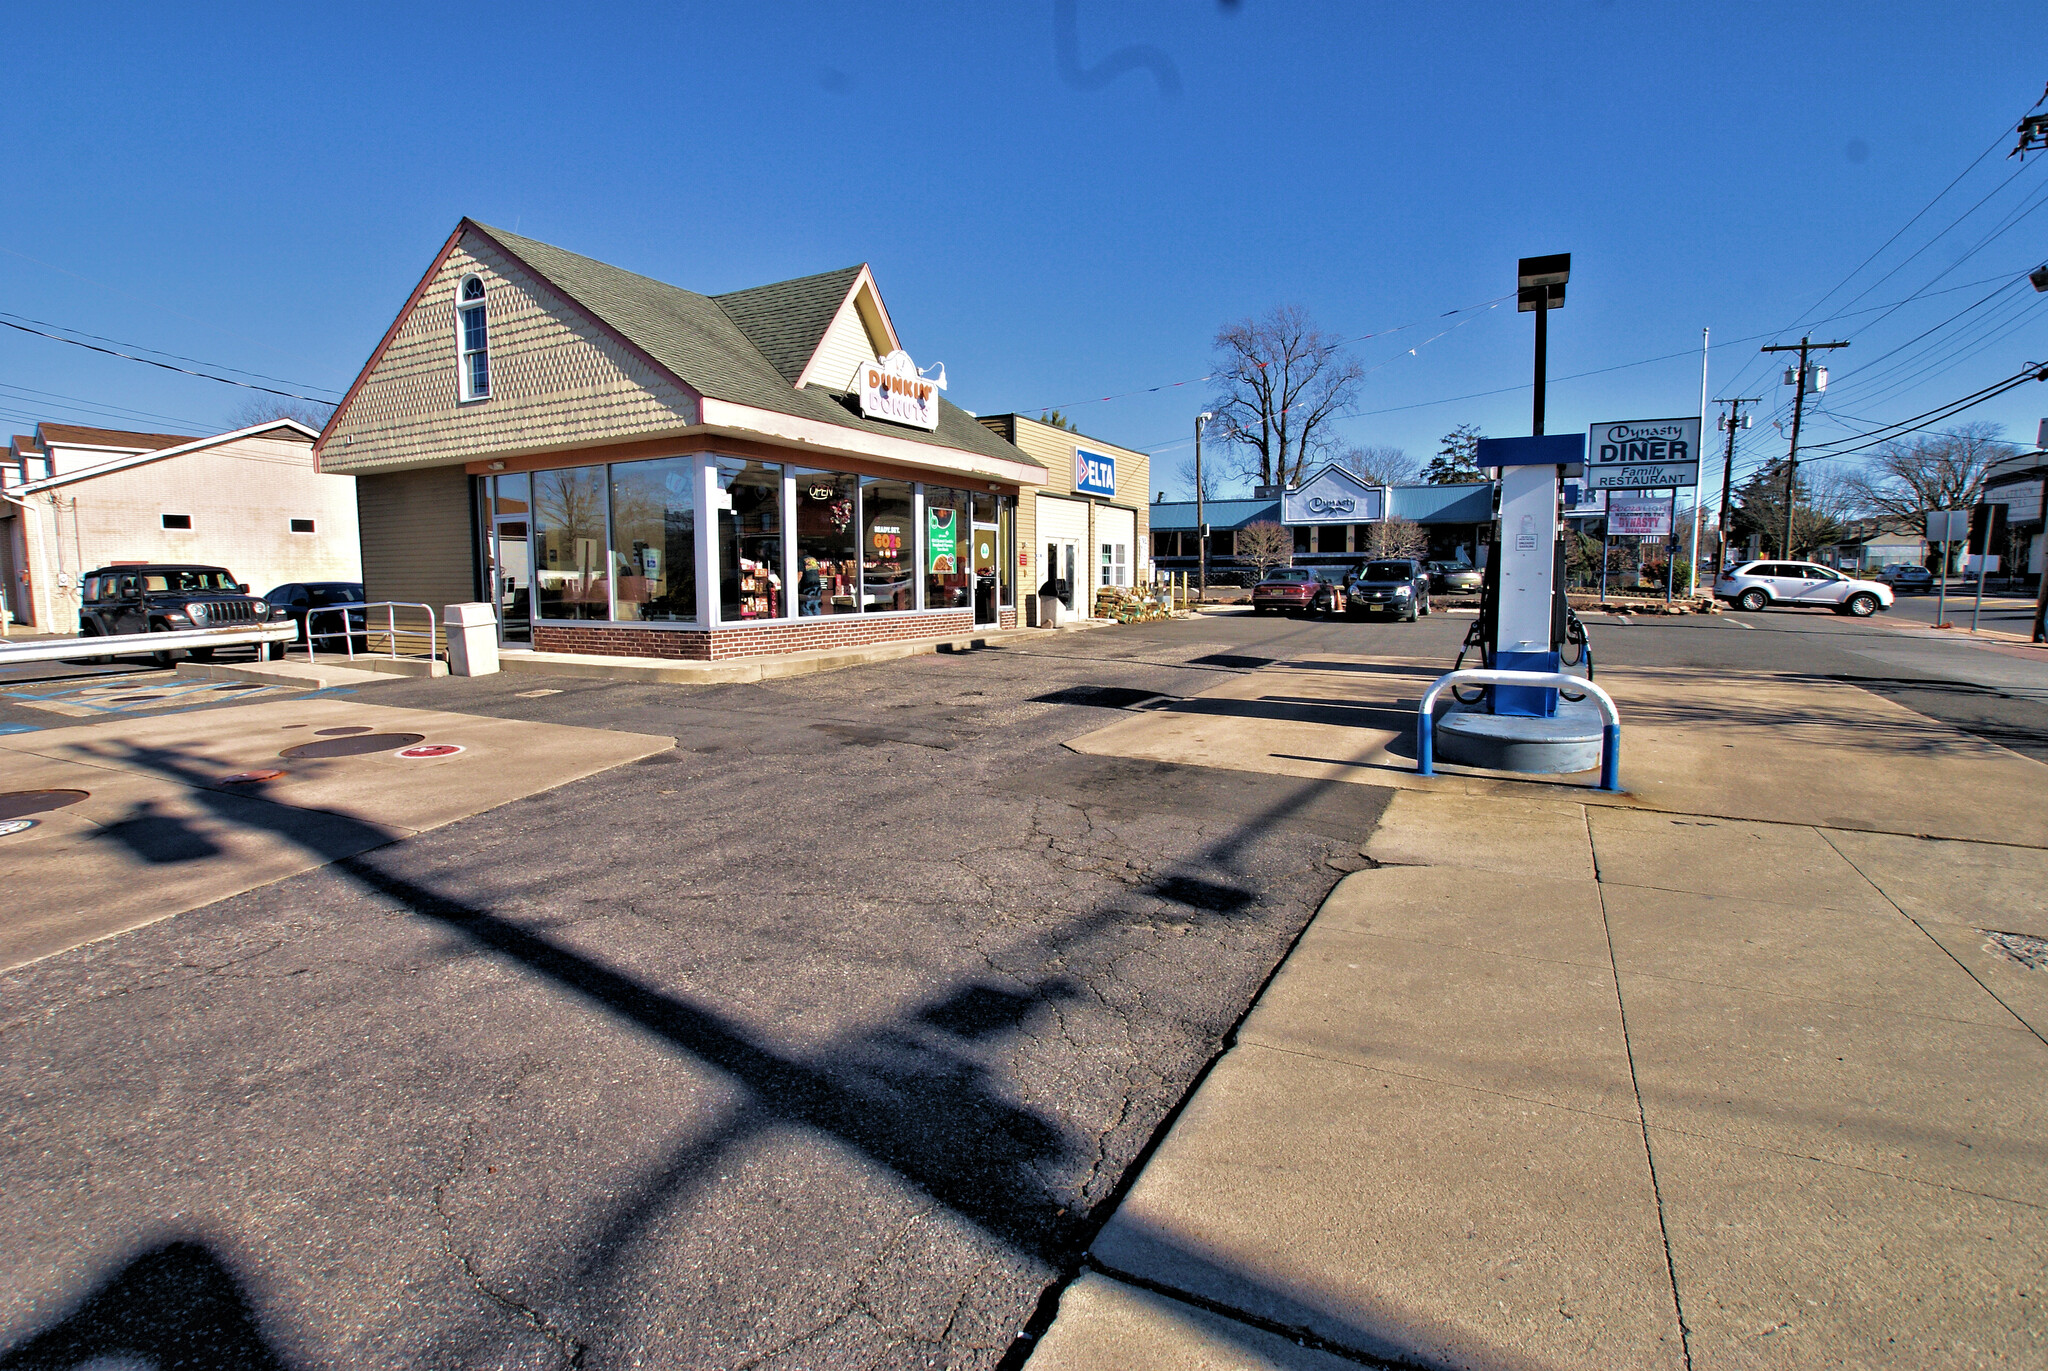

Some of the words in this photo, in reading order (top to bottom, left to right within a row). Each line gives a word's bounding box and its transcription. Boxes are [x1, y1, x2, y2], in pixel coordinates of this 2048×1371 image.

[868, 369, 933, 402] DUNKIN'
[869, 392, 930, 424] DONUTS
[1607, 424, 1683, 444] Dynasty
[1599, 440, 1689, 463] DINER
[1599, 474, 1687, 486] RESTAURANT
[1620, 466, 1664, 478] Family
[809, 484, 834, 497] OPEN
[1308, 497, 1357, 514] Dynasty
[1618, 517, 1661, 528] DYNASTY
